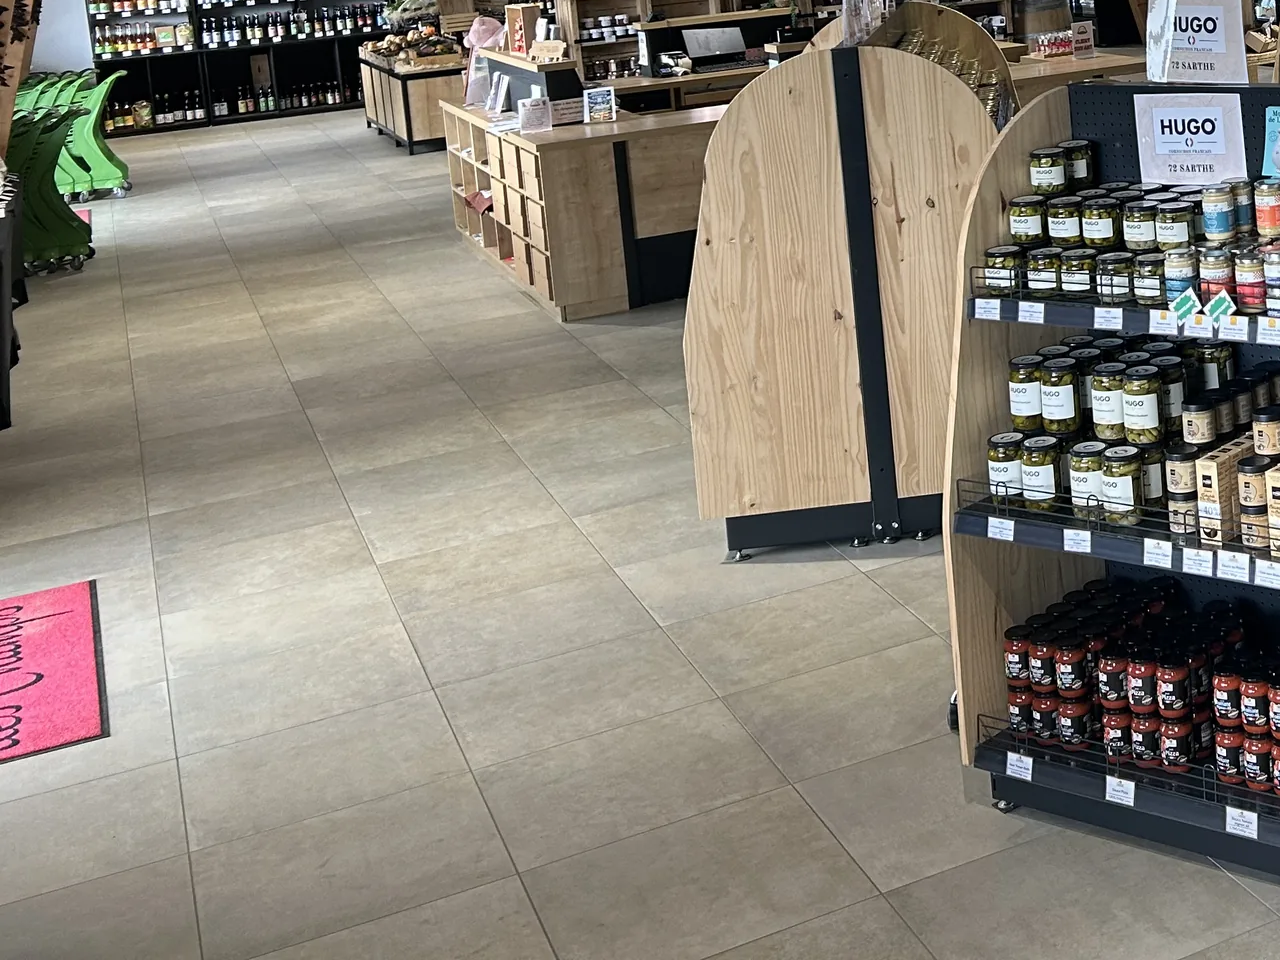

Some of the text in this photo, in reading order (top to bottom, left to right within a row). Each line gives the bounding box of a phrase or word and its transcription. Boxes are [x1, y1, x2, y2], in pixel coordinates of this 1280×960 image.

[1171, 61, 1216, 70] 72 SARTHE
[1160, 118, 1216, 136] HUGO
[1168, 163, 1215, 173] 72 SARTHE
